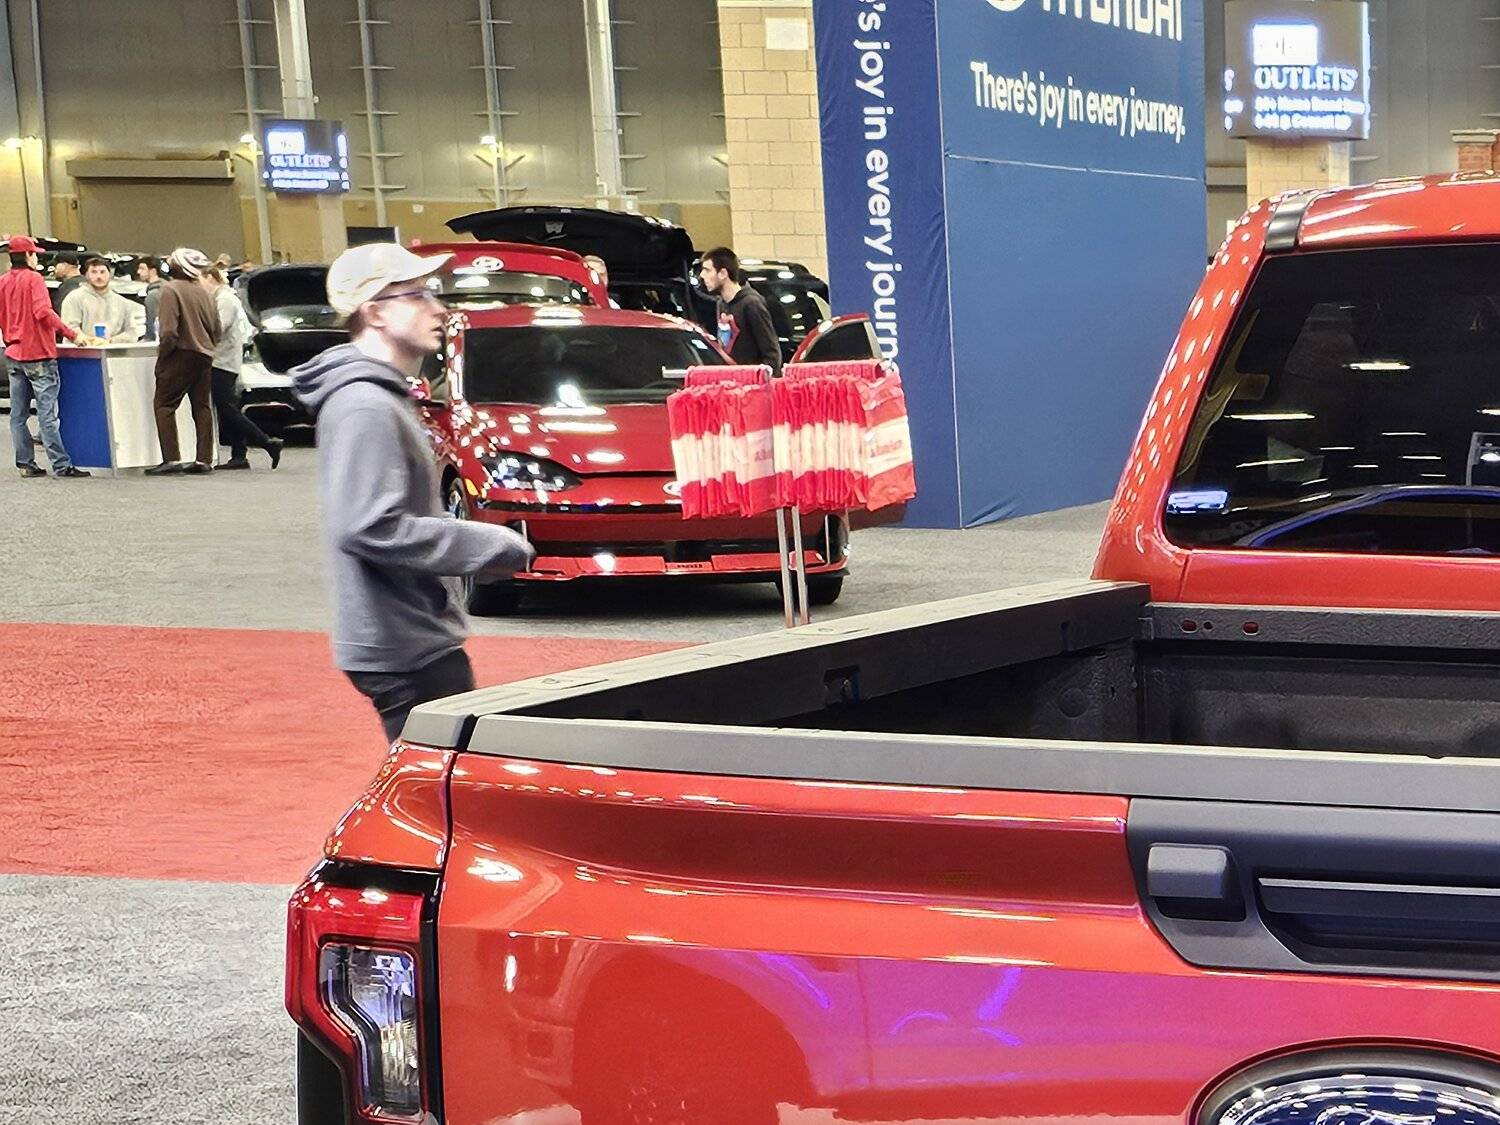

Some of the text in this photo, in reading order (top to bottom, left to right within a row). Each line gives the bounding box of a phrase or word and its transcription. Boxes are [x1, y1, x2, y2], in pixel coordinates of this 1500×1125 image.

[853, 39, 891, 99] joy
[1254, 66, 1359, 92] OUTLETS
[863, 106, 894, 140] in
[970, 61, 1038, 116] There's
[1039, 71, 1066, 128] joy
[1067, 75, 1084, 122] in
[1086, 90, 1129, 137] every
[1130, 86, 1186, 144] journey.
[864, 149, 894, 256] every
